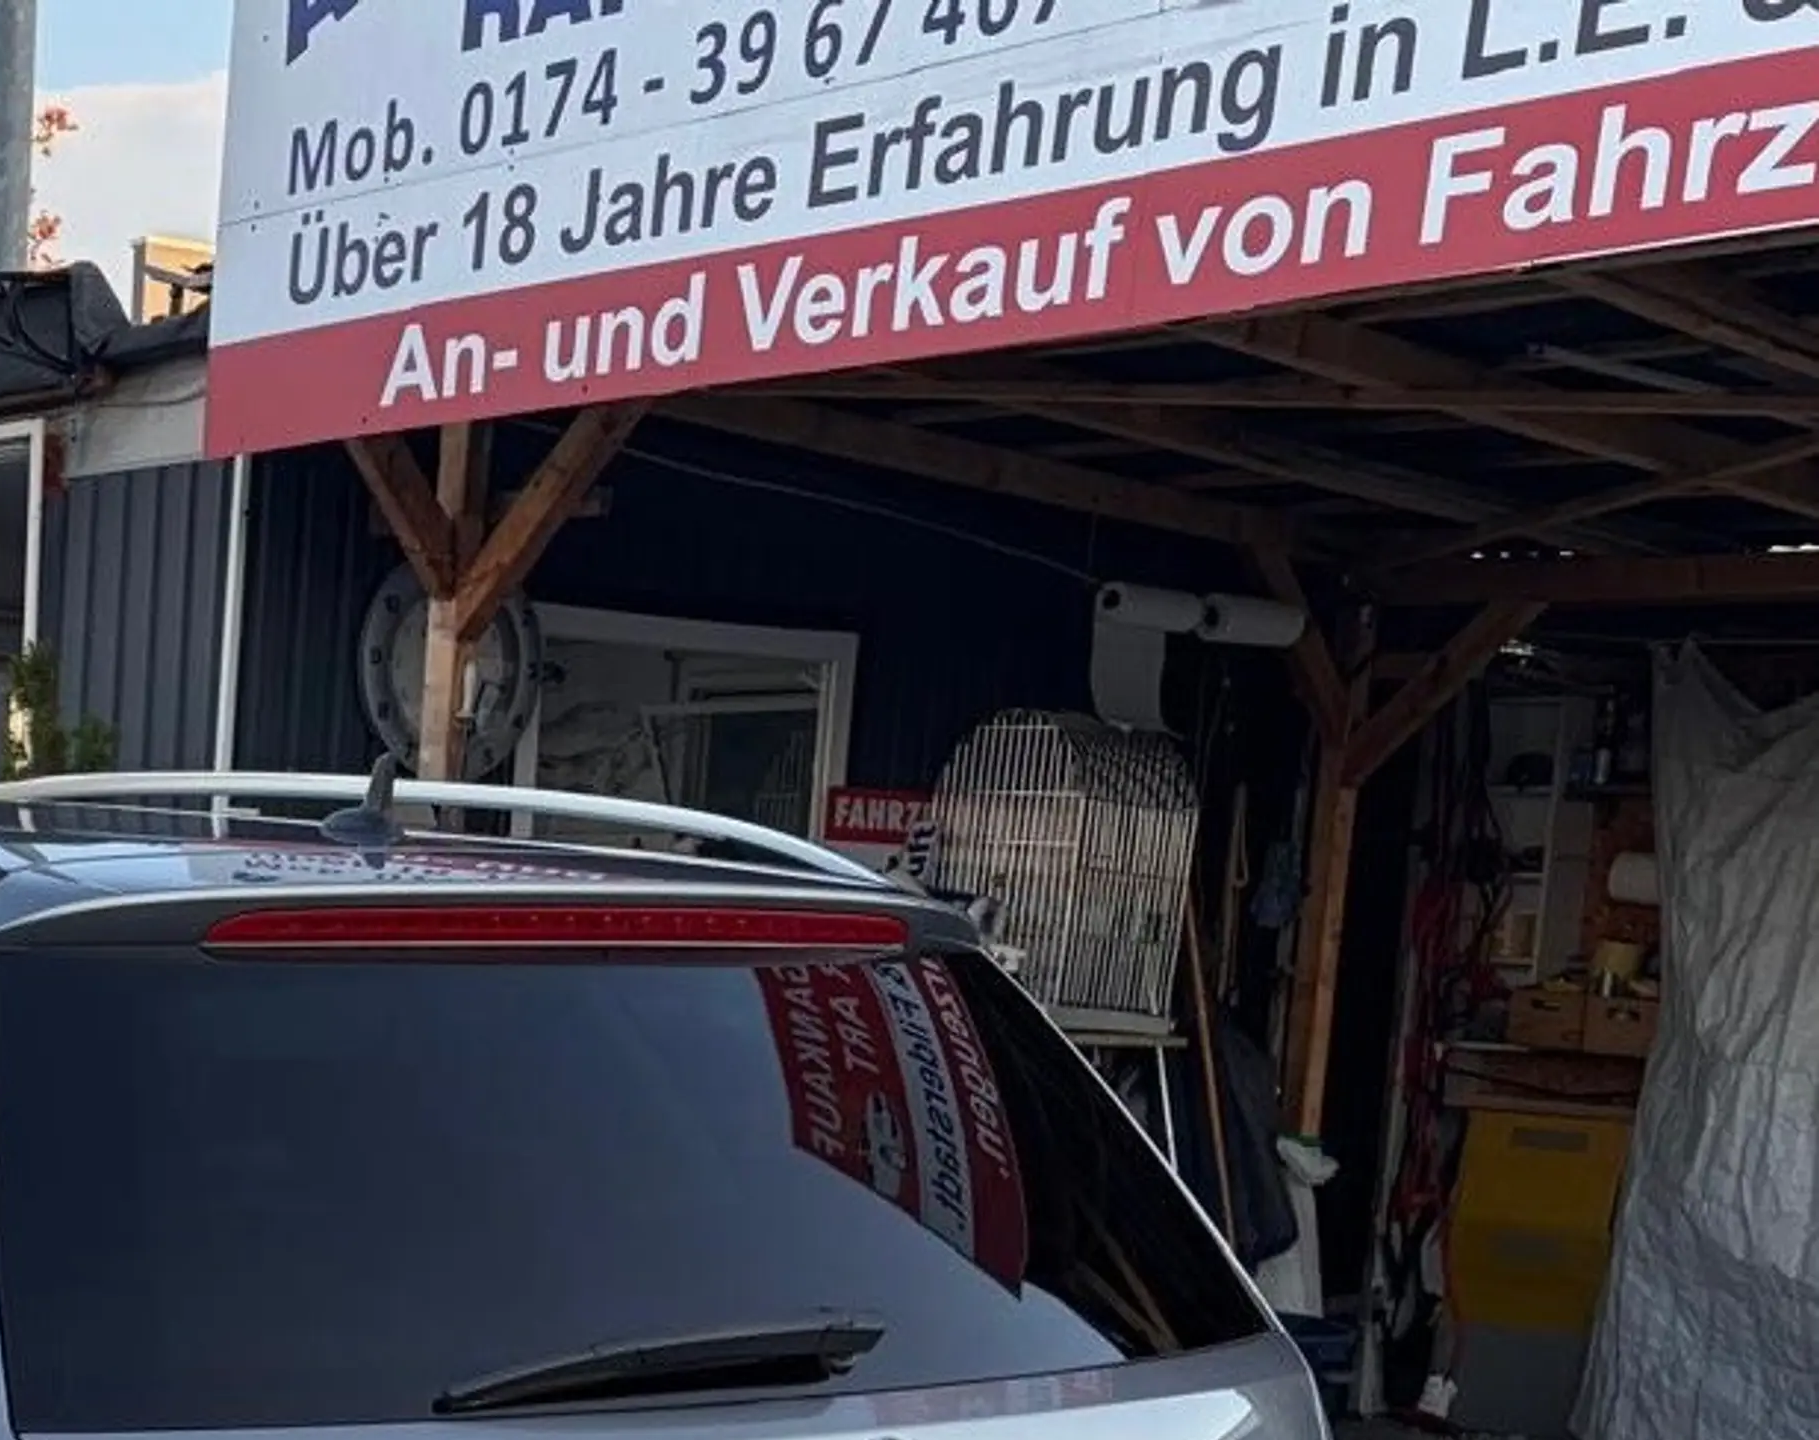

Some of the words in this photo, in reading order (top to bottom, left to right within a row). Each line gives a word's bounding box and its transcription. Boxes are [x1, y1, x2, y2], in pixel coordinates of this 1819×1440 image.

[287, 98, 434, 196] Mob.
[460, 48, 619, 154] 0174
[689, 9, 777, 106] 39
[288, 210, 438, 306] Über
[462, 183, 537, 273] 18
[560, 153, 777, 254] Jahre
[808, 43, 1282, 209] Erfahrung
[1320, 0, 1418, 107] in
[380, 322, 517, 407] An-
[542, 273, 707, 384] und
[736, 196, 1132, 352] Verkauf
[1154, 176, 1374, 285] von
[1419, 100, 1819, 247] Fahrz
